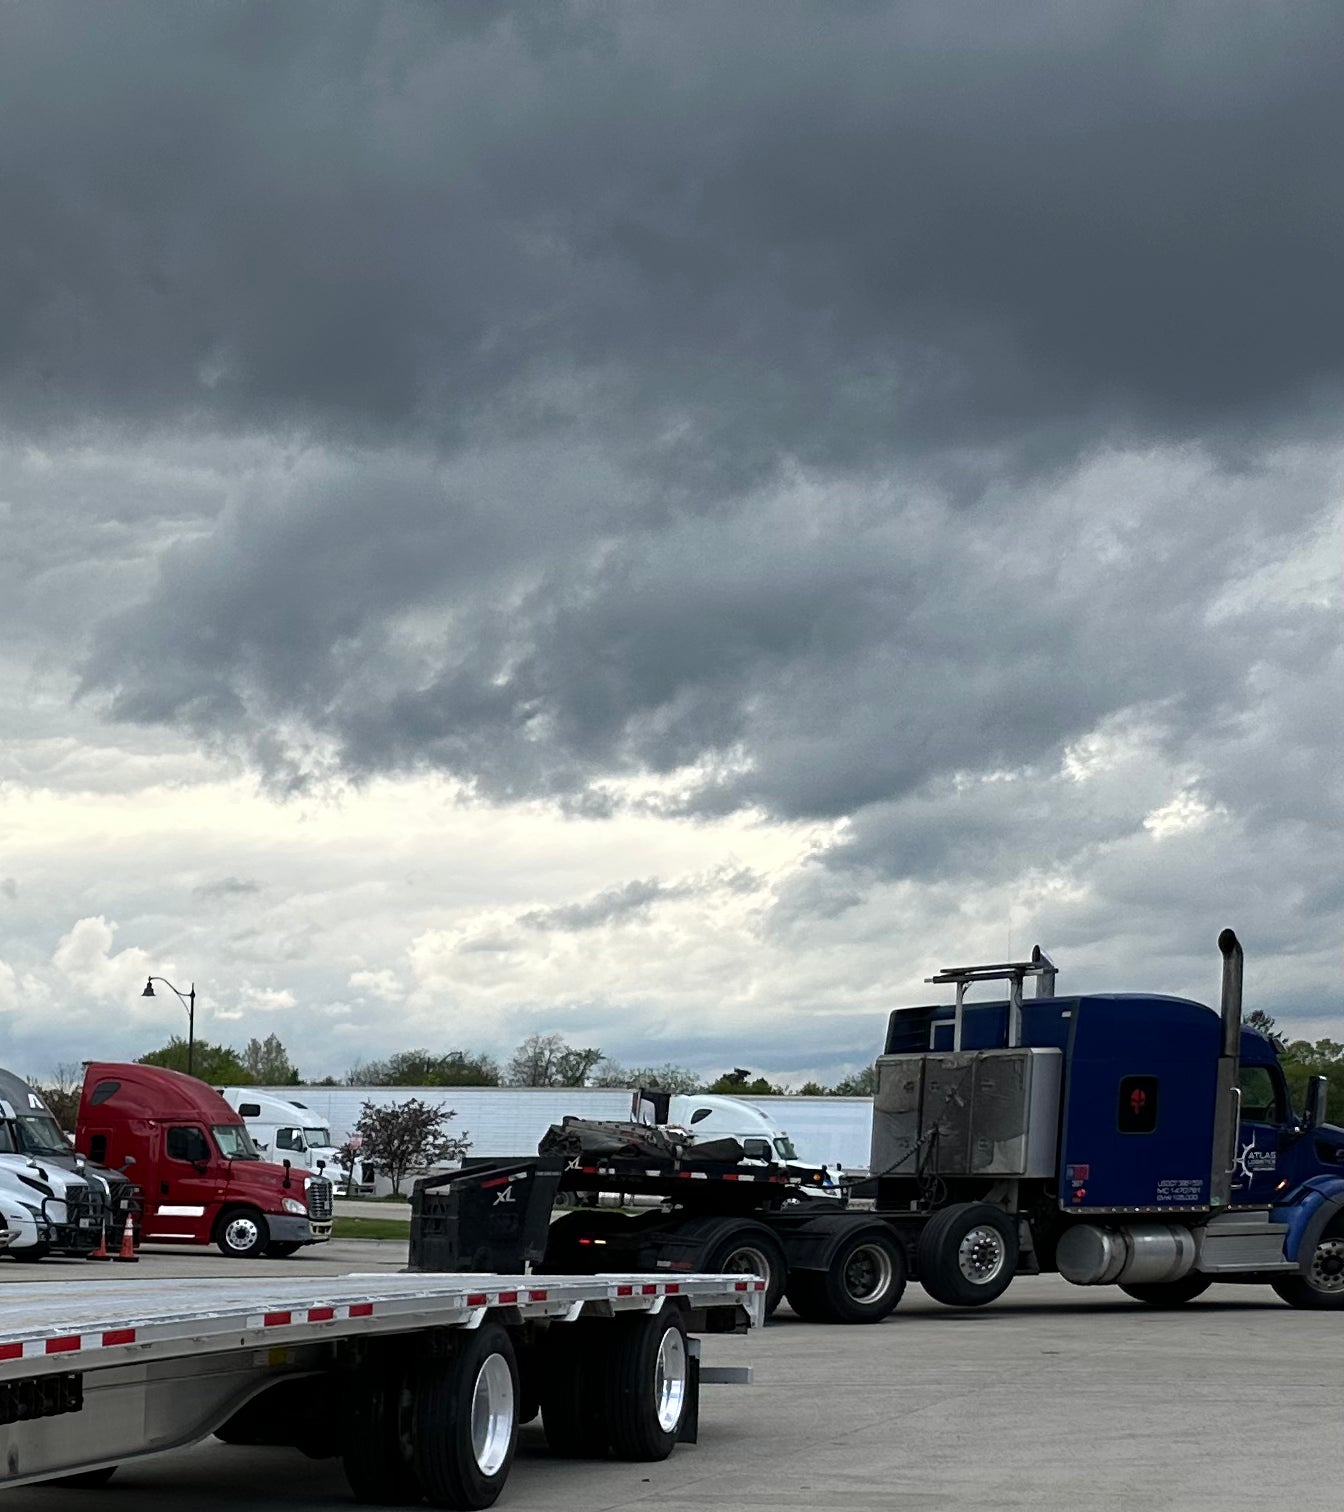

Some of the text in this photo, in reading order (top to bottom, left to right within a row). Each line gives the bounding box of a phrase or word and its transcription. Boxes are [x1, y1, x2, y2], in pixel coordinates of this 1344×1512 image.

[564, 1155, 583, 1171] XL
[1247, 1151, 1277, 1159] ATLAS
[492, 1185, 516, 1206] XL
